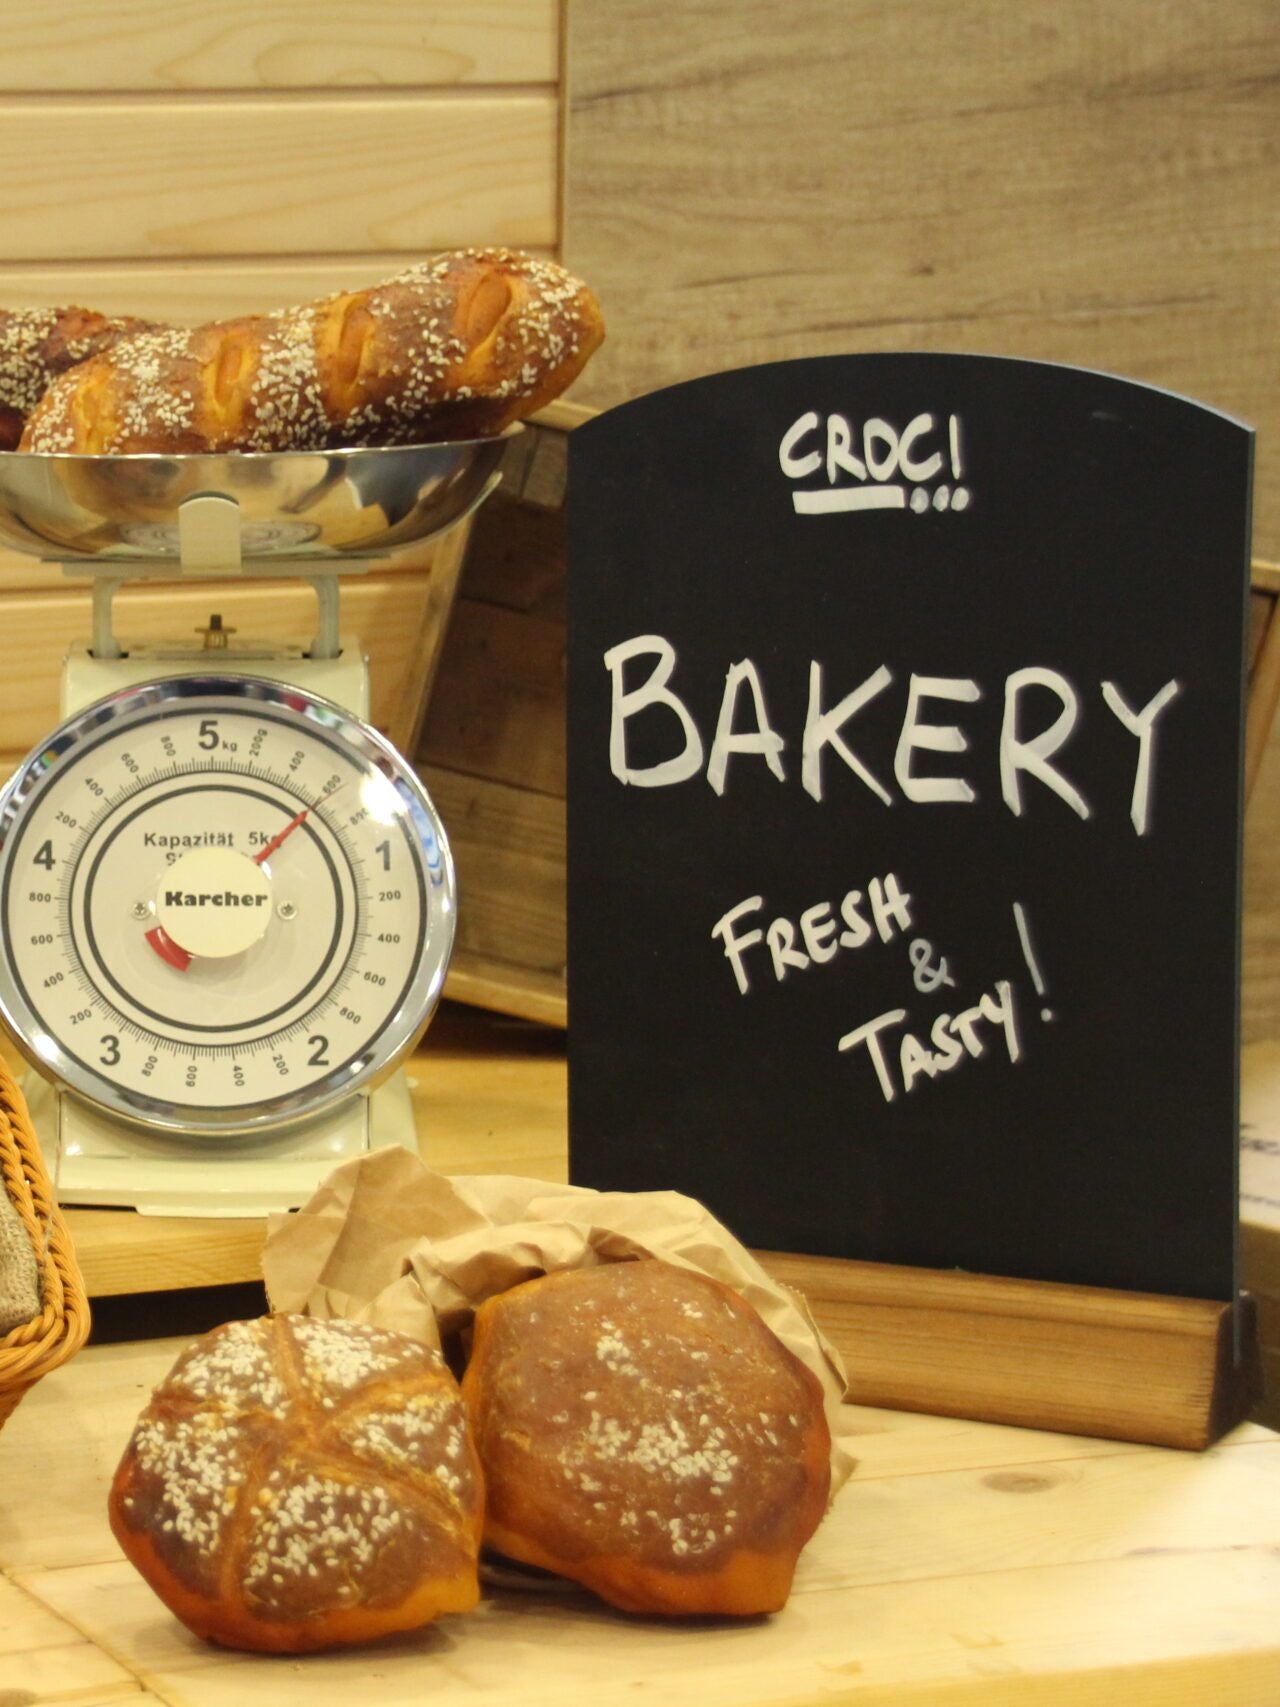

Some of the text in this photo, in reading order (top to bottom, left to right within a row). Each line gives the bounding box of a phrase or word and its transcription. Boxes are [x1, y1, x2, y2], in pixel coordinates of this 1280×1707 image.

[160, 735, 177, 758] 800
[198, 720, 238, 752] 5 kg
[248, 728, 269, 757] 200g
[604, 635, 1178, 836] BAKERY
[120, 752, 140, 774] 600
[288, 750, 306, 772] 400
[84, 777, 104, 797] 400
[322, 773, 342, 795] 600
[55, 811, 78, 829] 200
[144, 832, 234, 850] Kapazität
[32, 839, 56, 871] 4
[375, 840, 392, 872] 1
[28, 892, 52, 903] 800
[165, 891, 269, 908] Karcher
[378, 890, 402, 902] 200
[30, 934, 54, 946] 600
[377, 934, 401, 944] 400
[711, 873, 913, 994] FRESH
[909, 938, 956, 992] &
[42, 972, 65, 989] 400
[363, 971, 387, 987] 600
[69, 1008, 93, 1026] 200
[338, 1007, 362, 1025] 800
[99, 1034, 122, 1067] 3
[306, 1034, 330, 1067] 2
[141, 1055, 159, 1078] 800
[232, 1065, 246, 1087] 400
[272, 1054, 290, 1076] 200
[184, 1065, 199, 1088] 600
